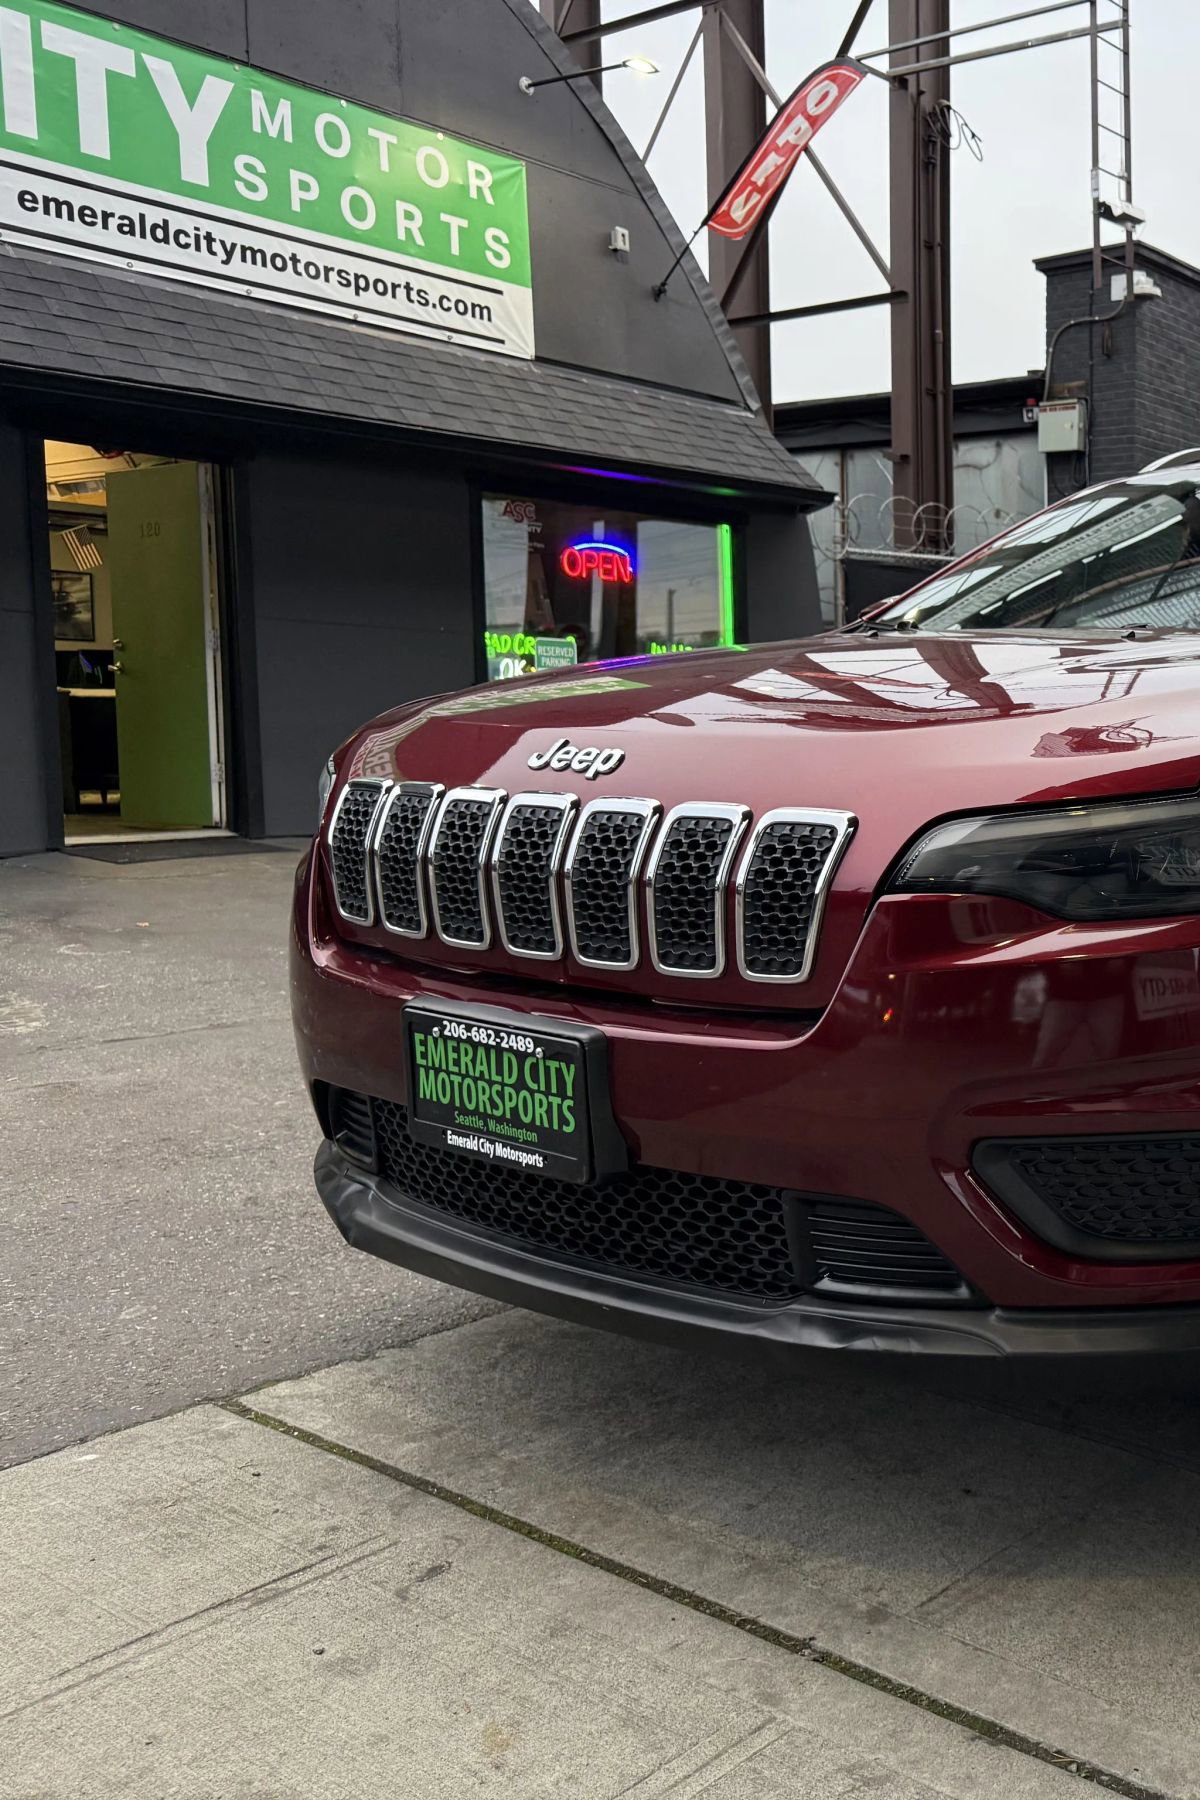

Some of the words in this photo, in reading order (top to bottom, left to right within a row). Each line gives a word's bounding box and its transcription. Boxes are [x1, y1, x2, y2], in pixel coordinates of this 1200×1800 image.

[251, 89, 494, 205] MOTOR
[234, 154, 511, 269] SPORTS
[17, 189, 493, 322] emeraldcitymotorsports.com
[502, 501, 536, 523] ASC
[562, 548, 632, 582] OPEN
[538, 646, 574, 657] RESERVED
[527, 738, 625, 781] Jeep
[443, 1021, 534, 1053] 206-682-2489
[414, 1032, 518, 1085] EMERALD
[524, 1055, 576, 1097] CITY
[419, 1068, 576, 1133] MOTORSPORTS
[454, 1111, 487, 1132] Seattle,
[487, 1118, 538, 1143] Washington
[447, 1130, 478, 1151] Emerald
[479, 1138, 495, 1159] City
[495, 1142, 543, 1168] Motorsports
